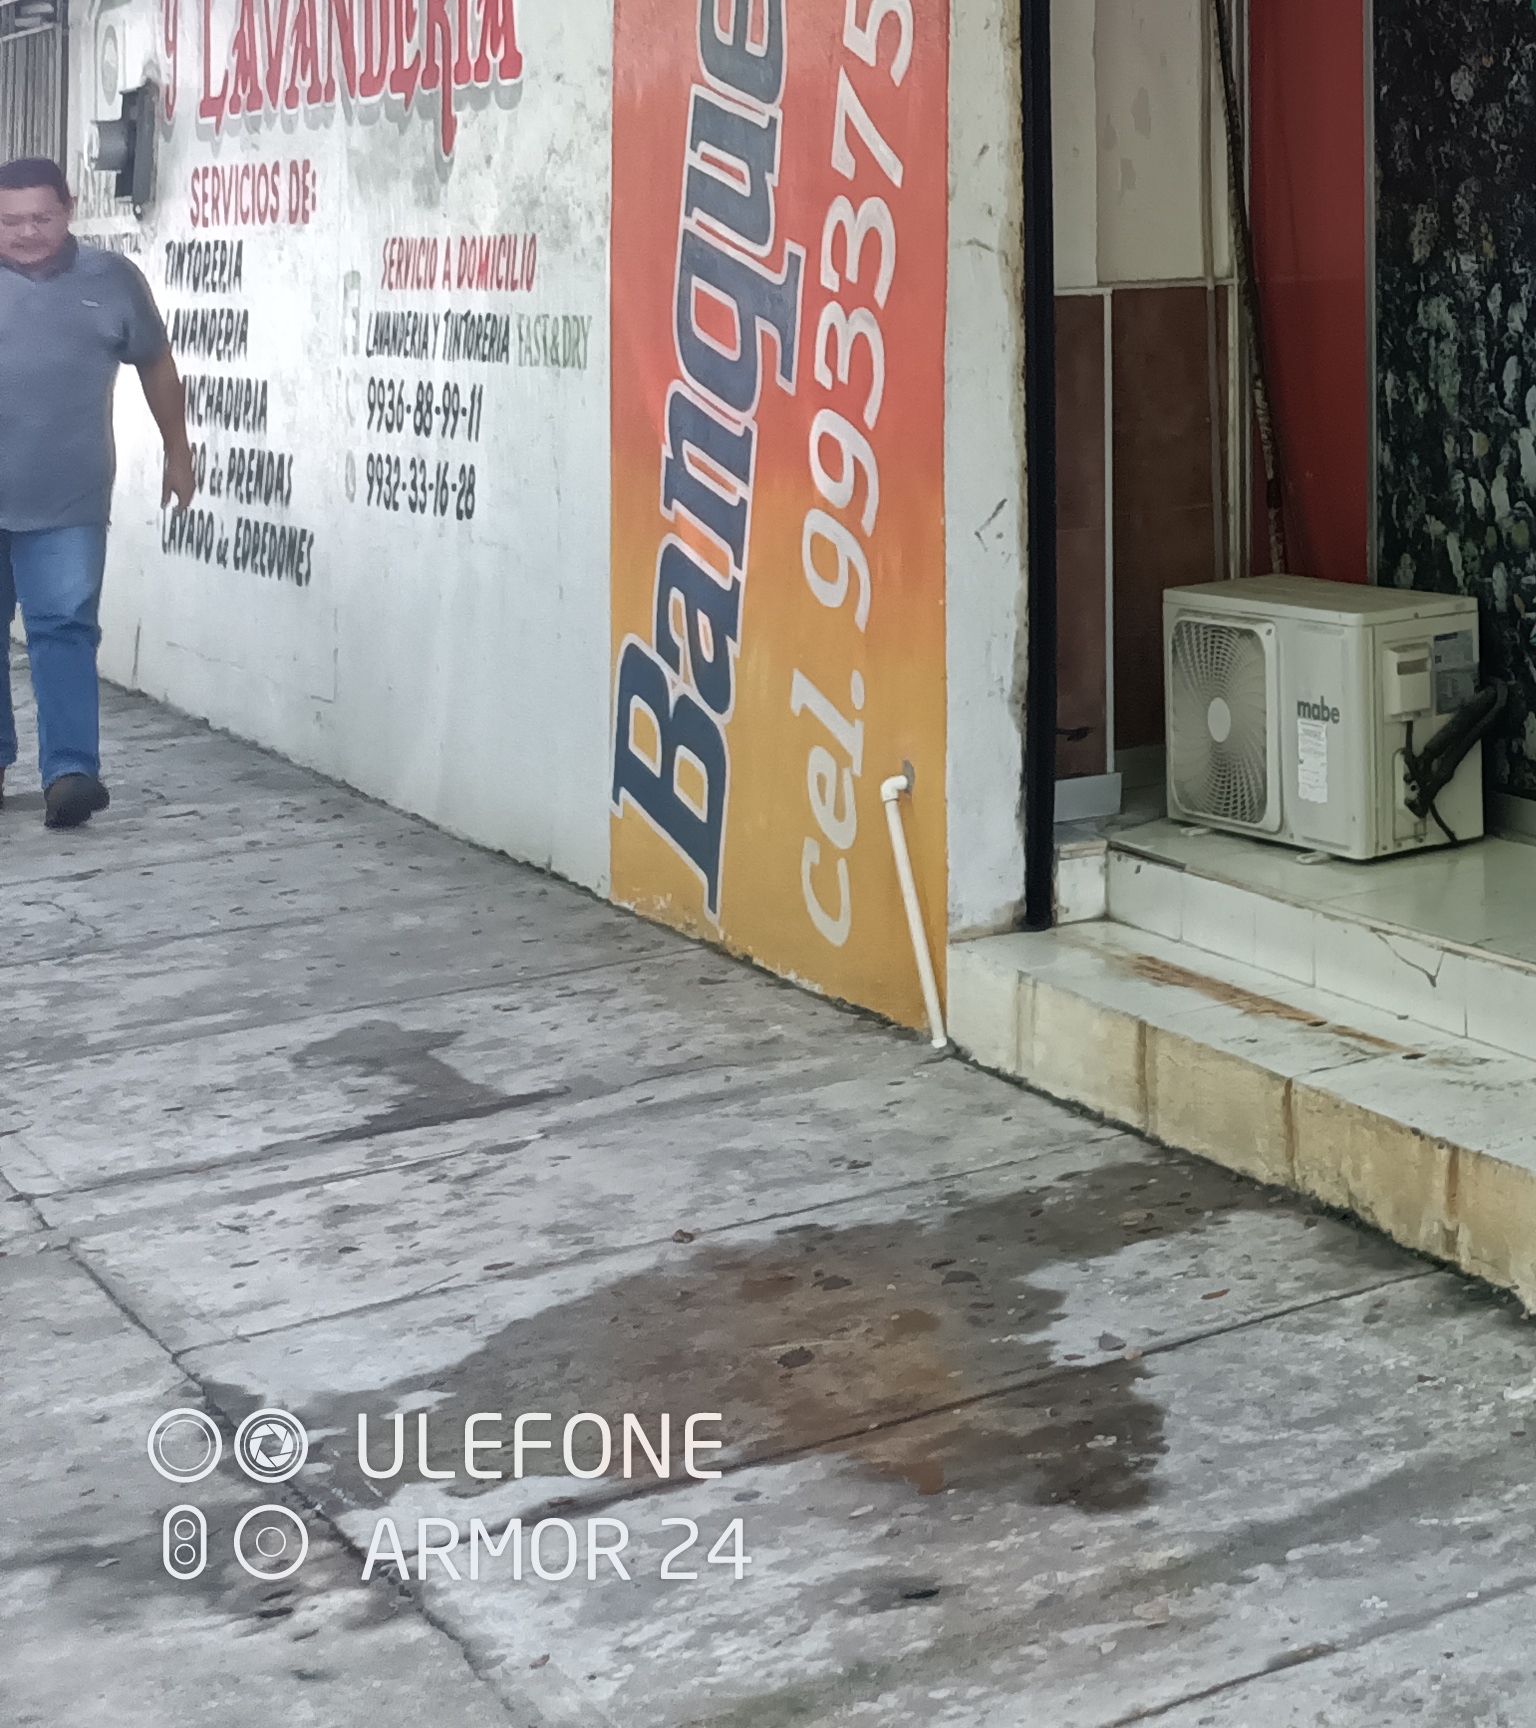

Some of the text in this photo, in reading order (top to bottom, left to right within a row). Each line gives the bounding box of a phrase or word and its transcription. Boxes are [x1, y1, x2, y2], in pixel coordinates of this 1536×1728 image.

[190, 158, 317, 228] SERVICIOS DE:
[165, 239, 243, 293] TINTORERIA
[381, 233, 537, 292] SERVICIO A DOMICILIO
[442, 308, 510, 365] TINTORERIA
[226, 447, 294, 508] PRENDAS
[1297, 696, 1340, 725] mabe
